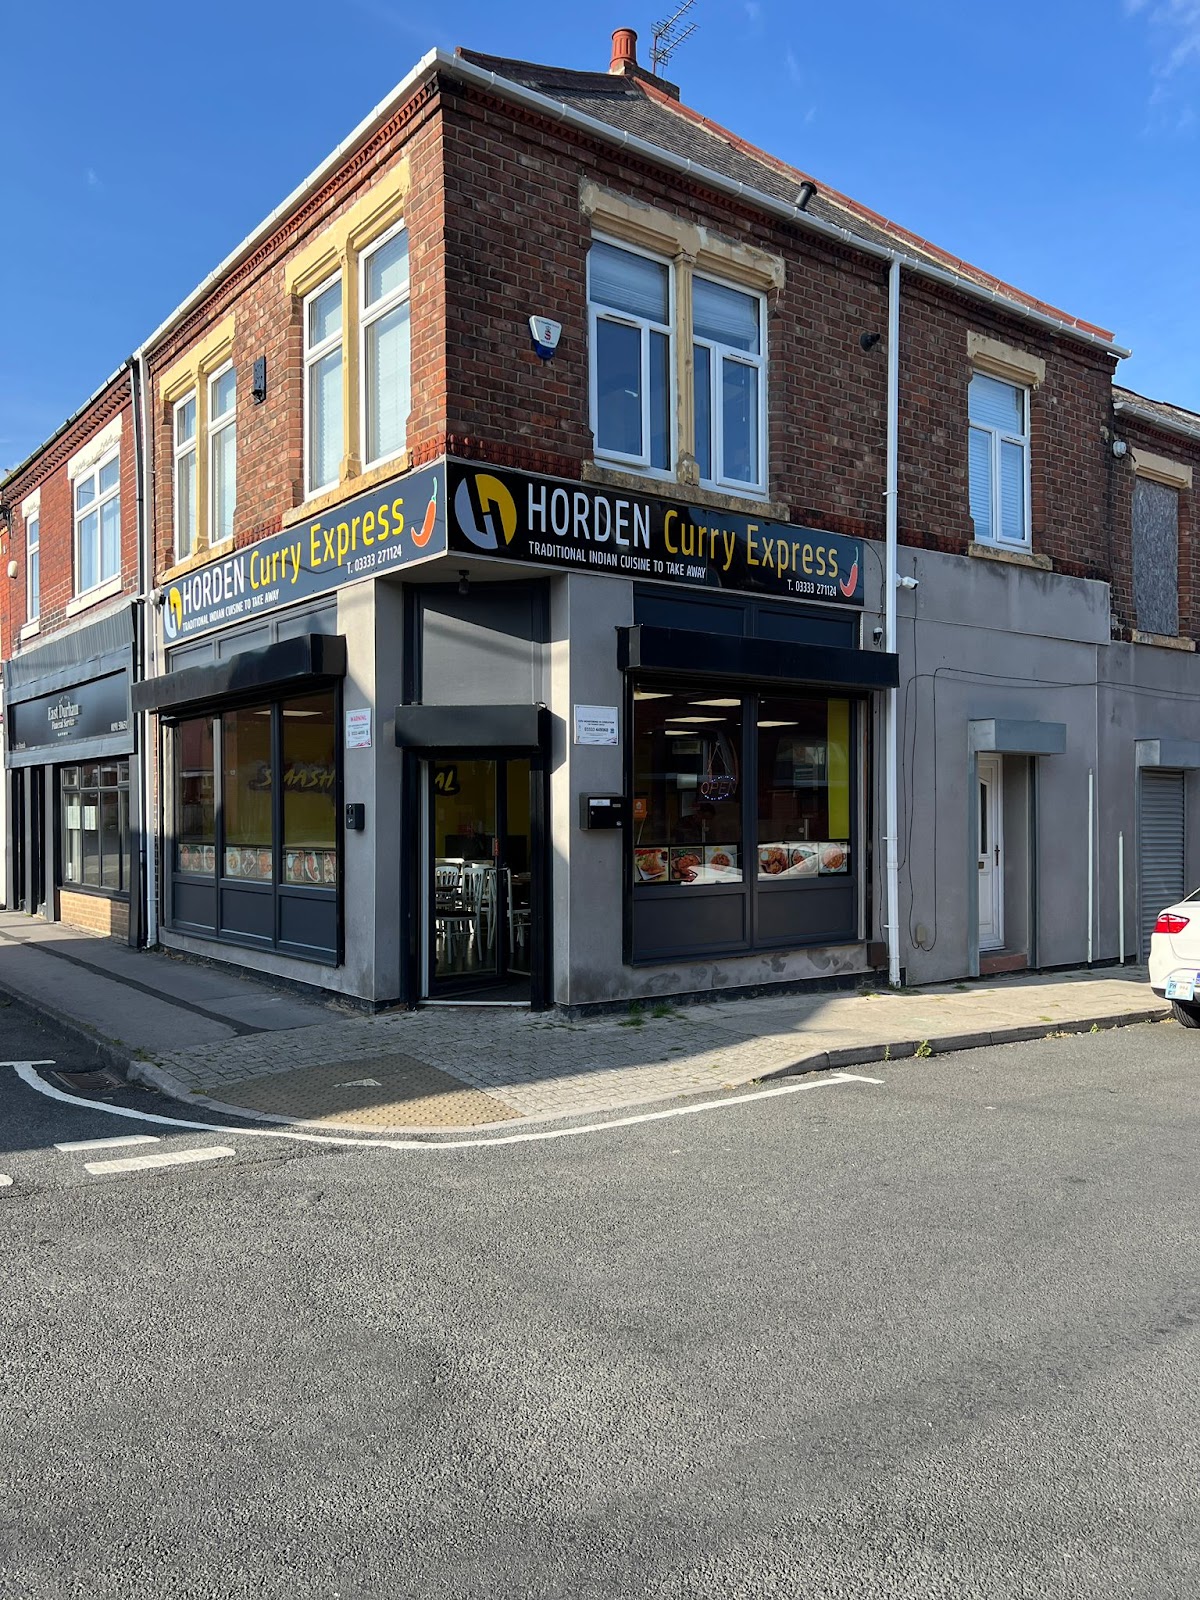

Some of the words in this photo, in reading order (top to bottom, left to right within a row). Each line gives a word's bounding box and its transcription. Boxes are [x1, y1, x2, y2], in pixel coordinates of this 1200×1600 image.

[528, 482, 650, 550] HORDEN
[664, 509, 736, 572] Curry
[747, 524, 839, 579] Express
[182, 556, 245, 616] HORDEN
[249, 541, 301, 590] Curry
[310, 498, 405, 567] Express
[346, 561, 353, 574] T.
[354, 553, 375, 571] 03333
[377, 544, 402, 564] 271124
[528, 541, 586, 562] TRADITIONAL
[589, 550, 618, 567] INDIAN
[620, 555, 650, 572] CUISINE
[653, 560, 664, 573] TO
[666, 562, 685, 576] TAKE
[686, 564, 707, 579] AWAY
[787, 579, 794, 591] T.
[795, 581, 815, 594] 03333
[816, 583, 837, 597] 271124
[182, 614, 209, 632] TRADITIONAL
[209, 608, 225, 620] INDIAN
[225, 602, 243, 617] CUISINE
[244, 598, 251, 610] TO
[251, 593, 264, 608] TAKE
[264, 588, 280, 603] AWAY
[48, 705, 59, 721] East
[59, 701, 80, 719] Durham
[701, 781, 738, 794] OPEN
